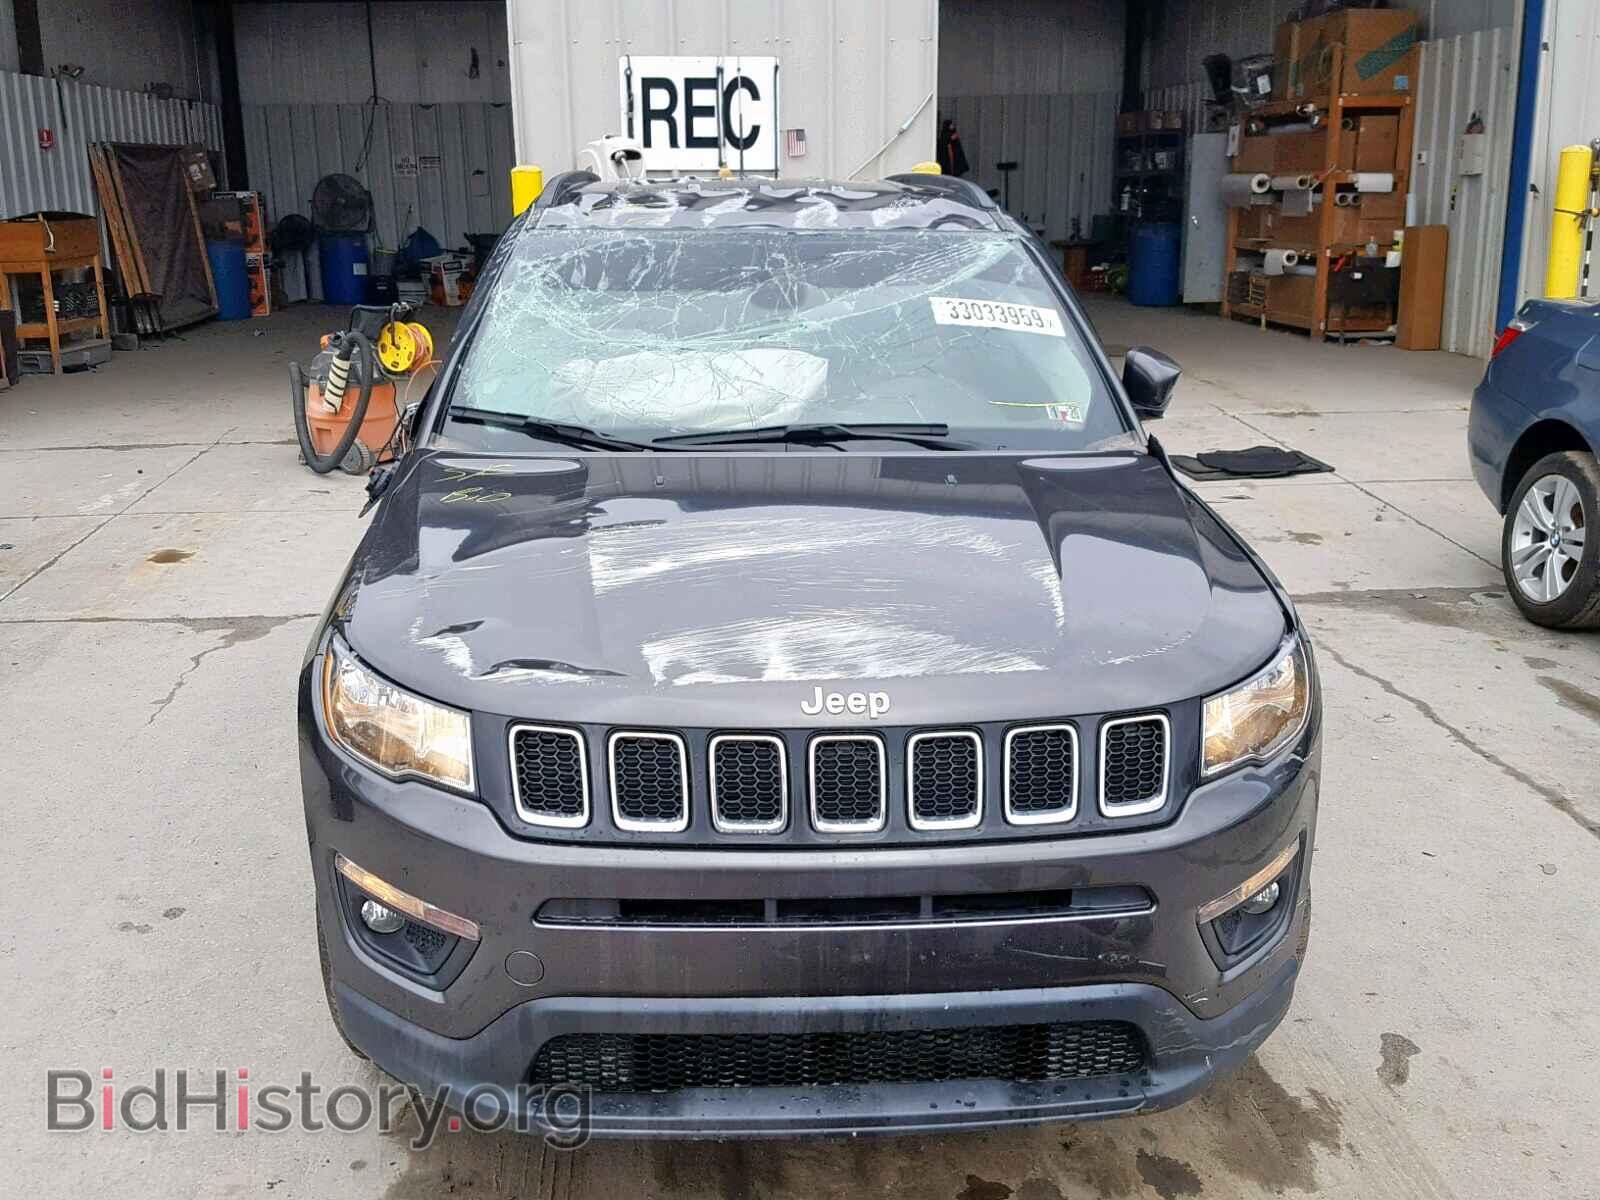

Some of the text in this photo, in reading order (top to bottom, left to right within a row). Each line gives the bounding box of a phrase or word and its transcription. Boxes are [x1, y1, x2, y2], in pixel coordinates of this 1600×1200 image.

[641, 76, 761, 150] REC
[946, 300, 1045, 328] 33033959
[800, 686, 891, 720] Jeep
